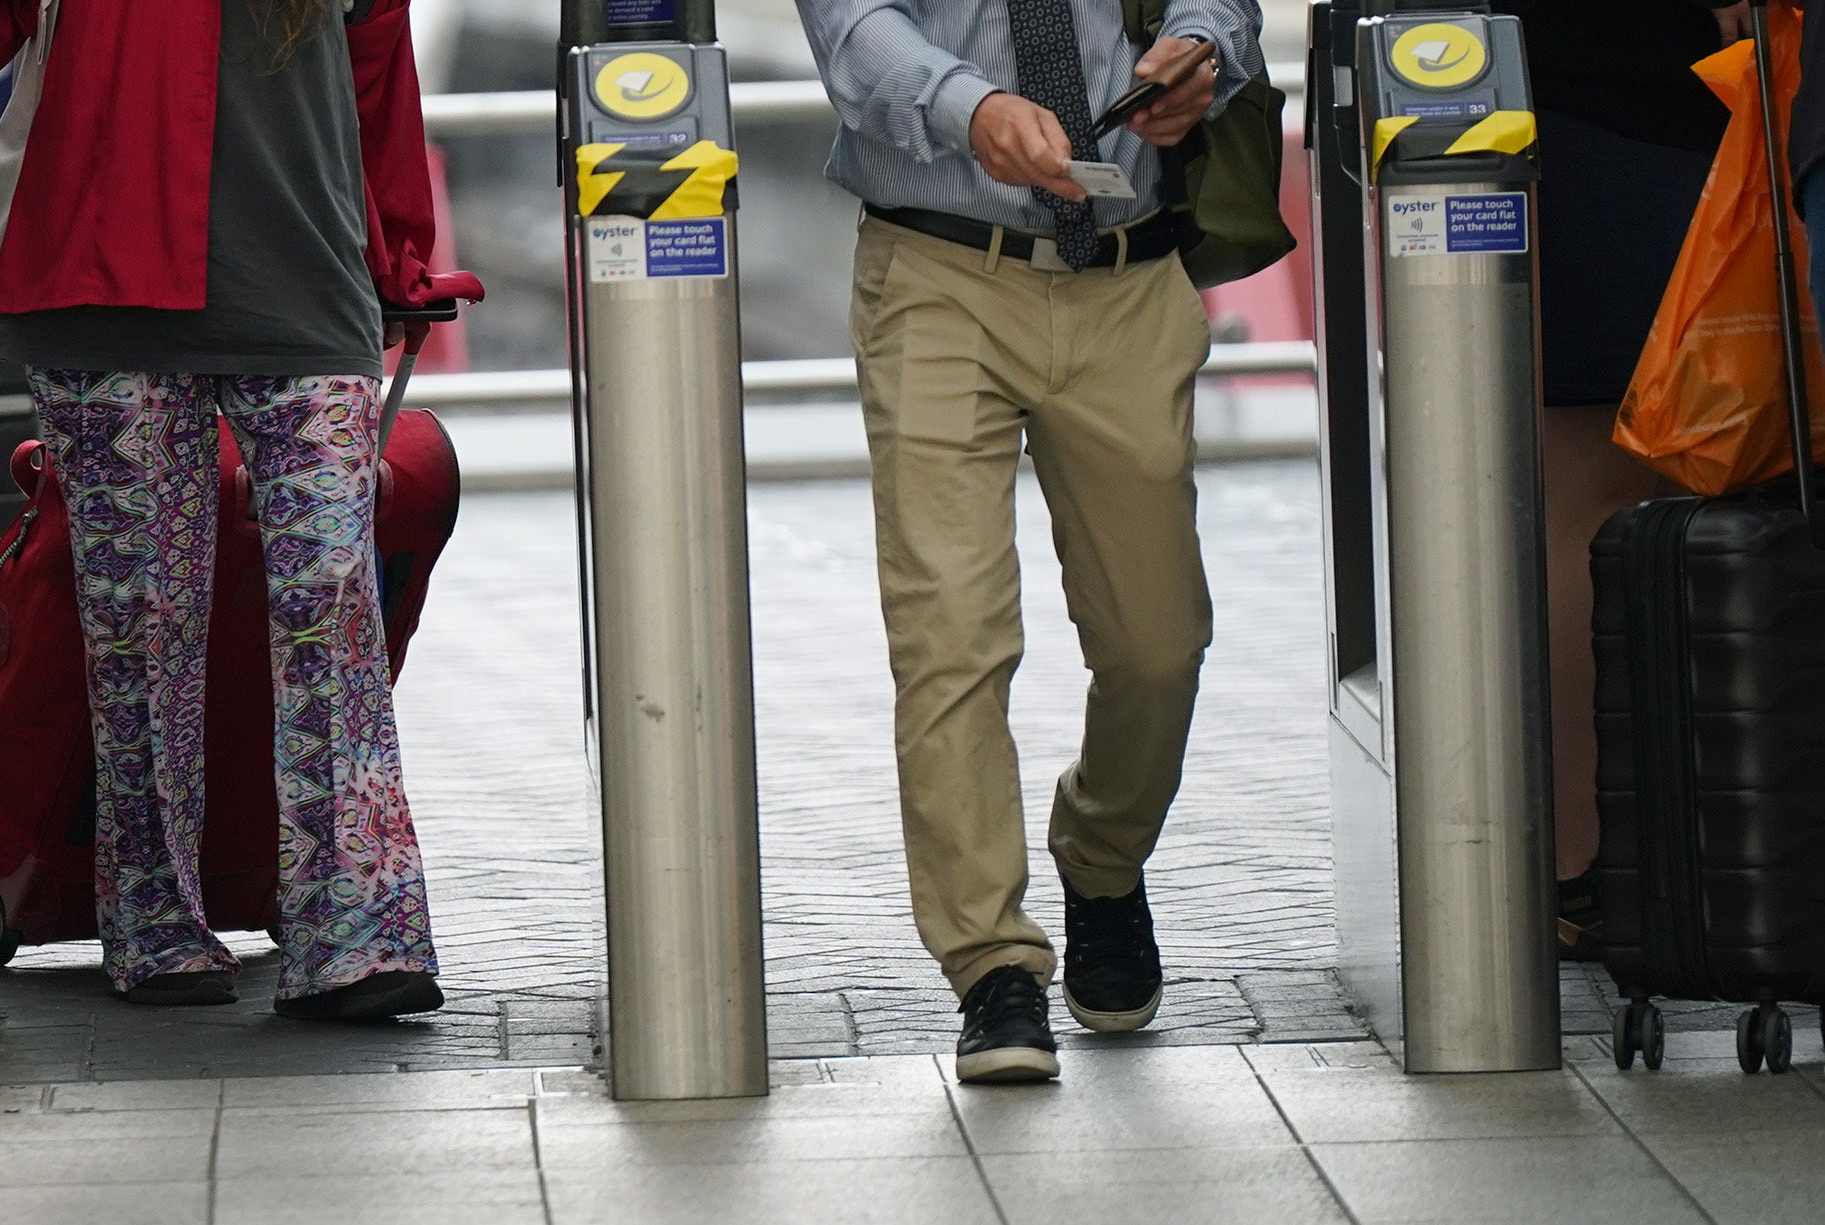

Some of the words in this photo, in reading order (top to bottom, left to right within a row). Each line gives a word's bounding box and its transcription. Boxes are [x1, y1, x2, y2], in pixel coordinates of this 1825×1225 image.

[1469, 104, 1486, 114] 33
[1393, 200, 1436, 215] oyster
[1450, 200, 1482, 210] Please
[1484, 199, 1513, 209] touch
[1450, 212, 1473, 223] your
[1476, 211, 1497, 220] card
[1499, 209, 1516, 219] flat
[593, 225, 636, 240] oyster
[649, 225, 682, 236] Please
[684, 224, 713, 234] touch
[1451, 224, 1465, 232] on
[1467, 222, 1484, 231] the
[1486, 221, 1517, 231] reader
[649, 237, 673, 248] your
[674, 236, 697, 246] card
[698, 234, 716, 245] flat
[650, 248, 664, 257] on
[666, 247, 684, 256] the
[685, 246, 717, 256] reader
